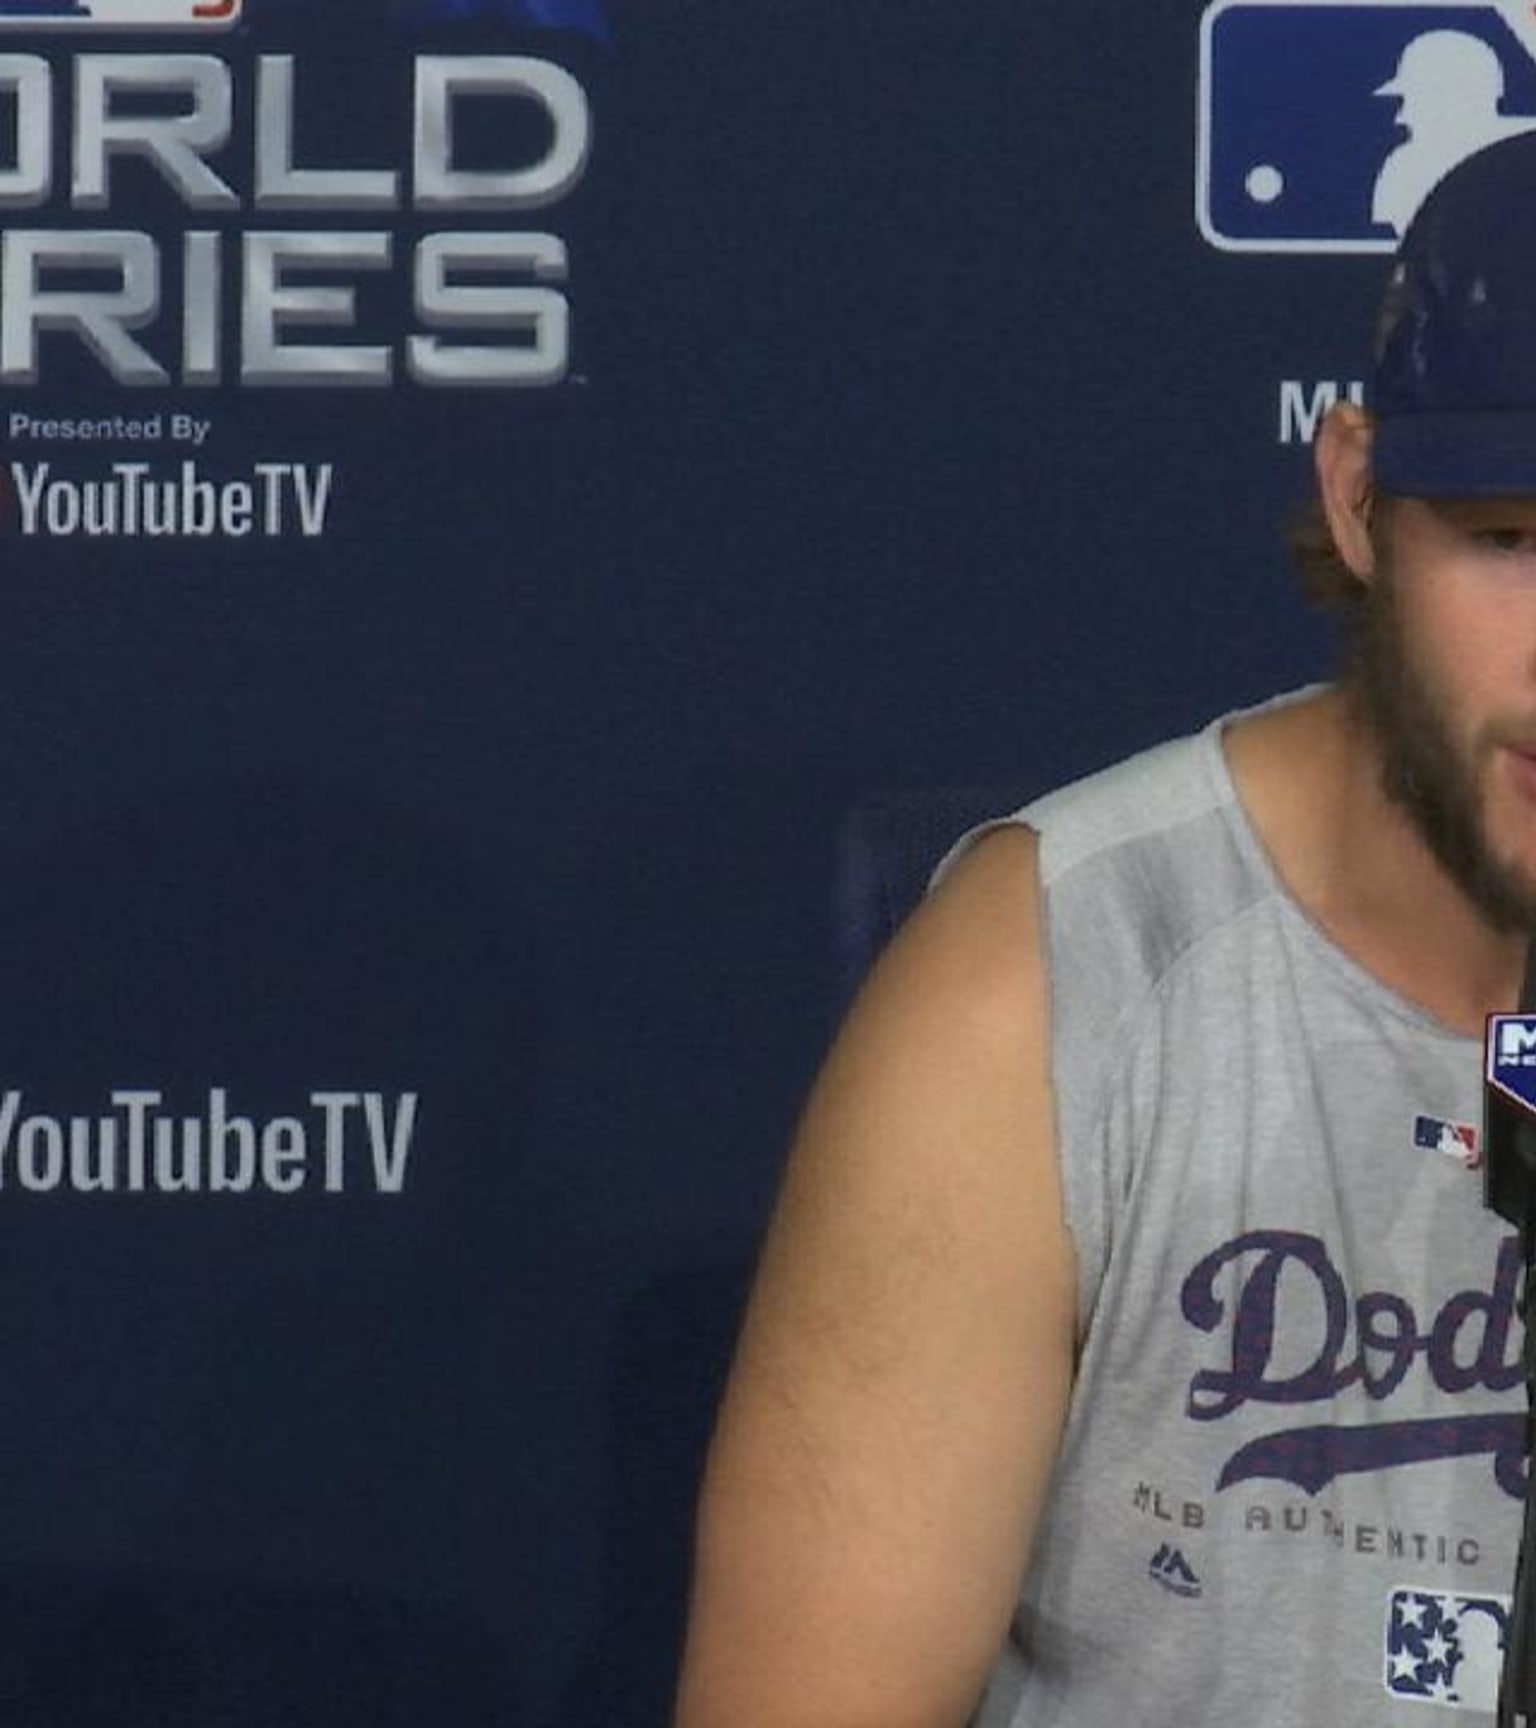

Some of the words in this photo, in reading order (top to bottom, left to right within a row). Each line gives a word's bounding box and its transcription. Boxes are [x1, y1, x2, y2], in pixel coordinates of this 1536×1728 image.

[8, 413, 162, 440] Presented
[170, 414, 211, 446] By
[1134, 1481, 1206, 1529] MLB
[1245, 1504, 1481, 1566] AUTHENTIC
